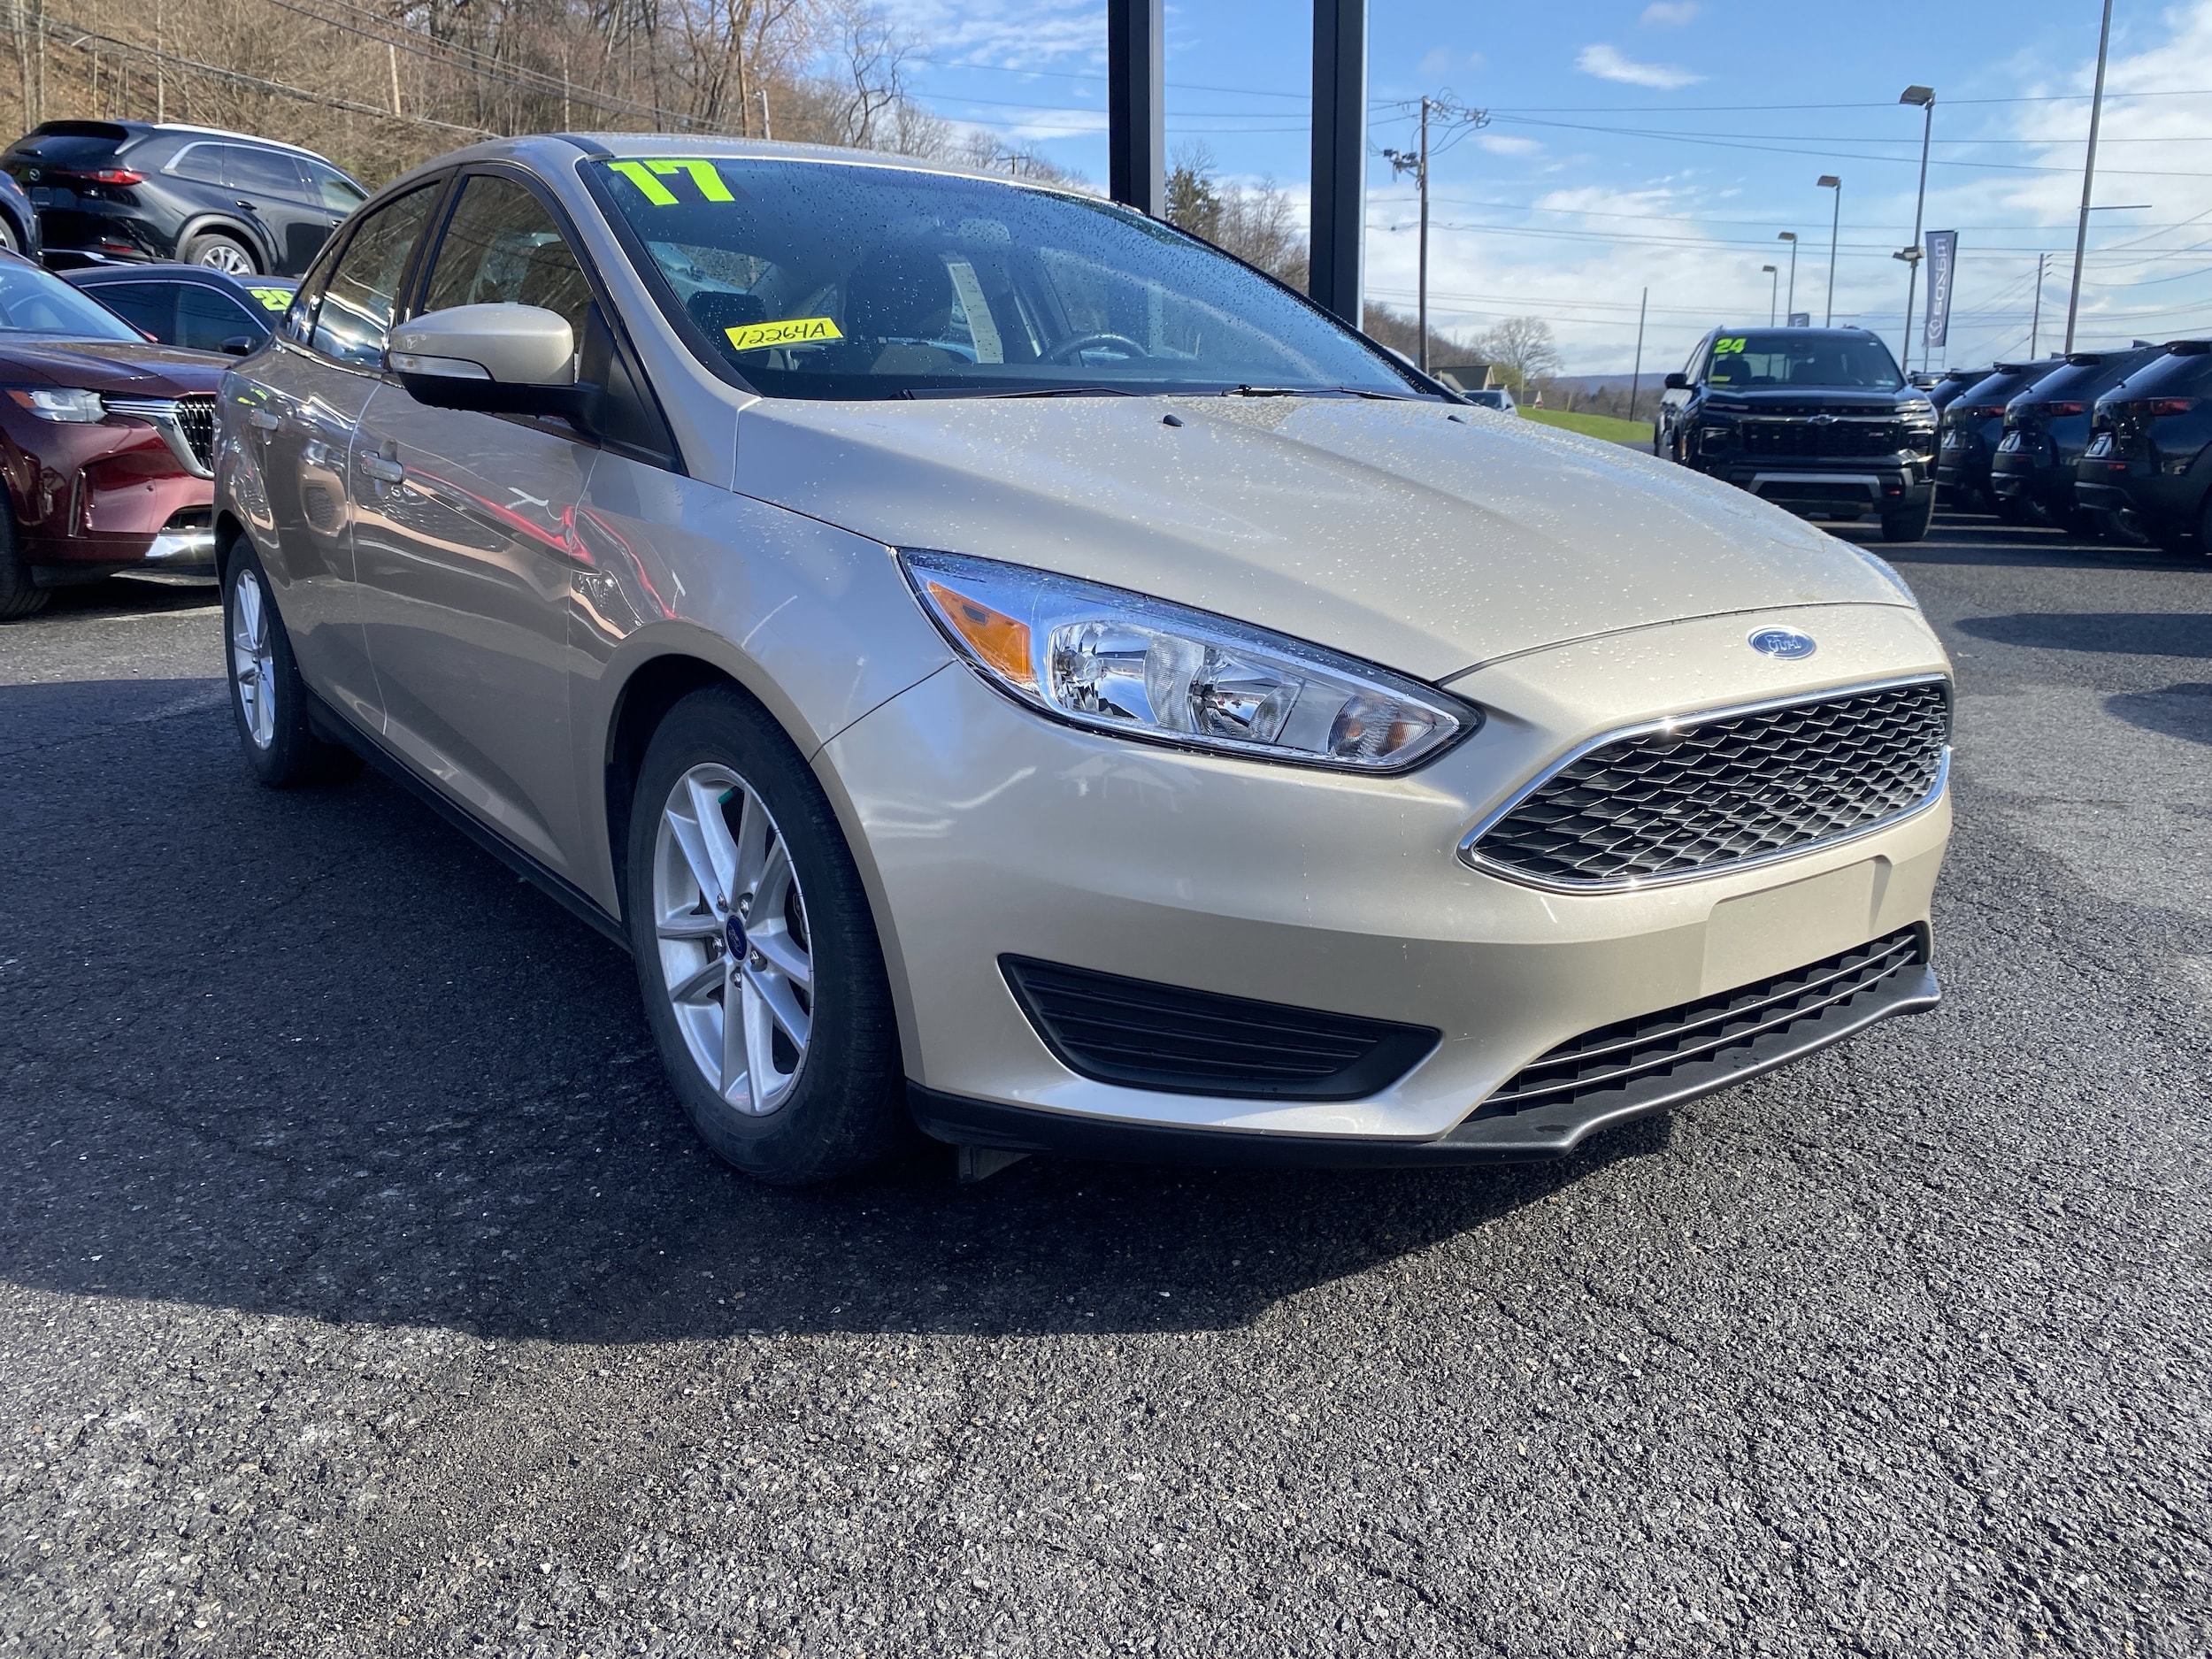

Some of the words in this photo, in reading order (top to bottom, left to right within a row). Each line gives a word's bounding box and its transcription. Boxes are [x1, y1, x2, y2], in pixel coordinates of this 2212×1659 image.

[607, 159, 735, 206] 17
[736, 320, 826, 346] 12264A
[1713, 337, 1747, 354] 24
[1763, 633, 1803, 653] Ford
